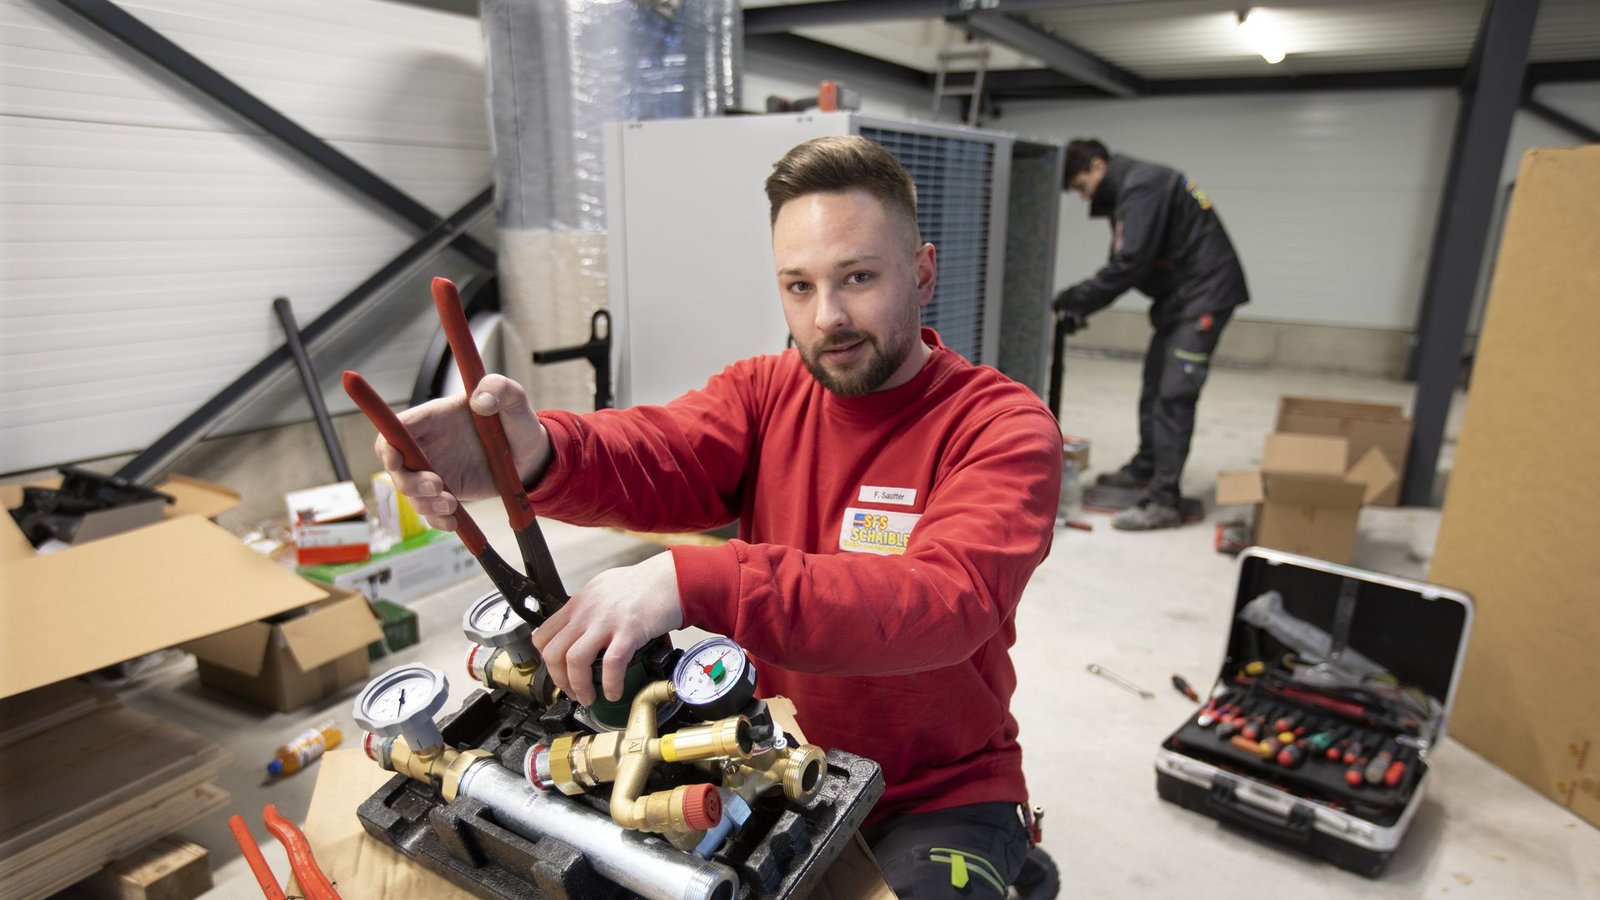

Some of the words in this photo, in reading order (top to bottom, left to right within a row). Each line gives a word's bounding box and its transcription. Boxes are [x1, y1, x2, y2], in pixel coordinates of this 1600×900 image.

[873, 490, 881, 499] F.
[881, 491, 905, 501] Sautter
[863, 513, 889, 531] SFS
